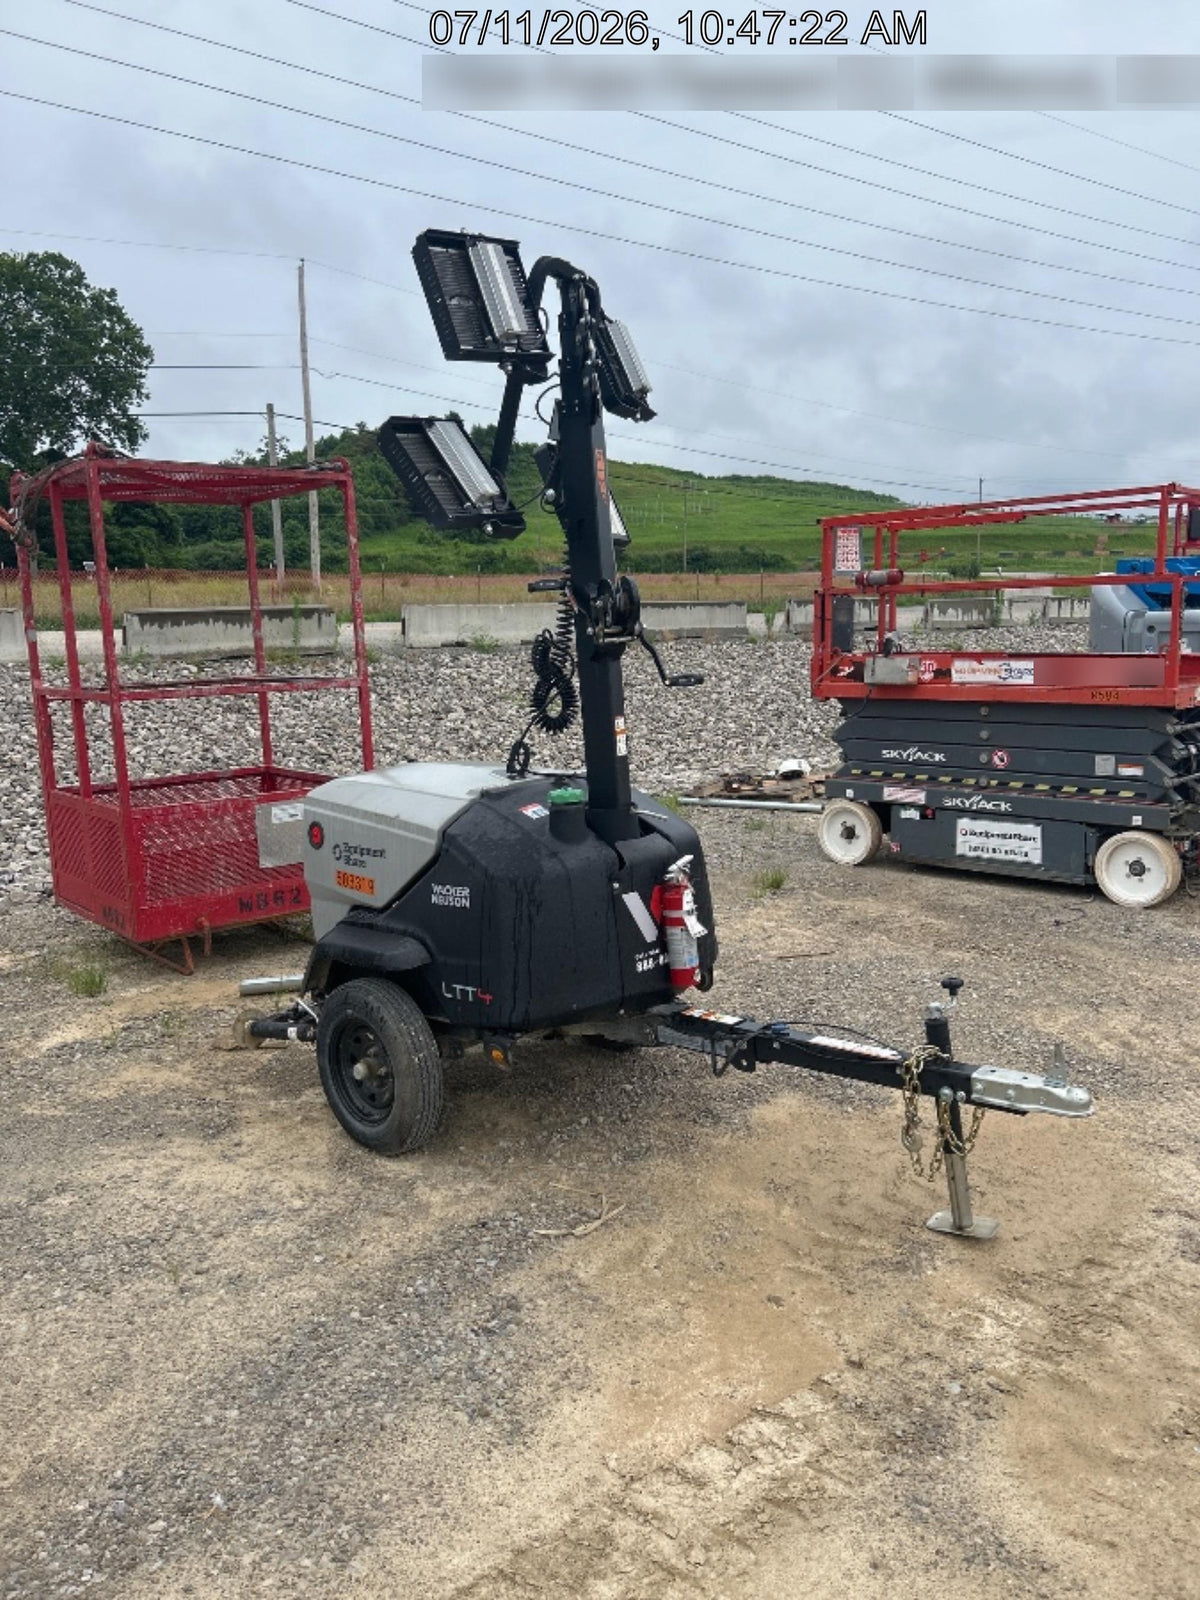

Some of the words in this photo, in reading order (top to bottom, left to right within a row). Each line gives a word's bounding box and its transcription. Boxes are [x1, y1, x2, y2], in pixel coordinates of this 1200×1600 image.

[881, 746, 947, 762] SKYJACK
[942, 794, 1013, 812] SKYJACK
[431, 883, 470, 897] WACKER
[431, 894, 470, 909] NEUSON
